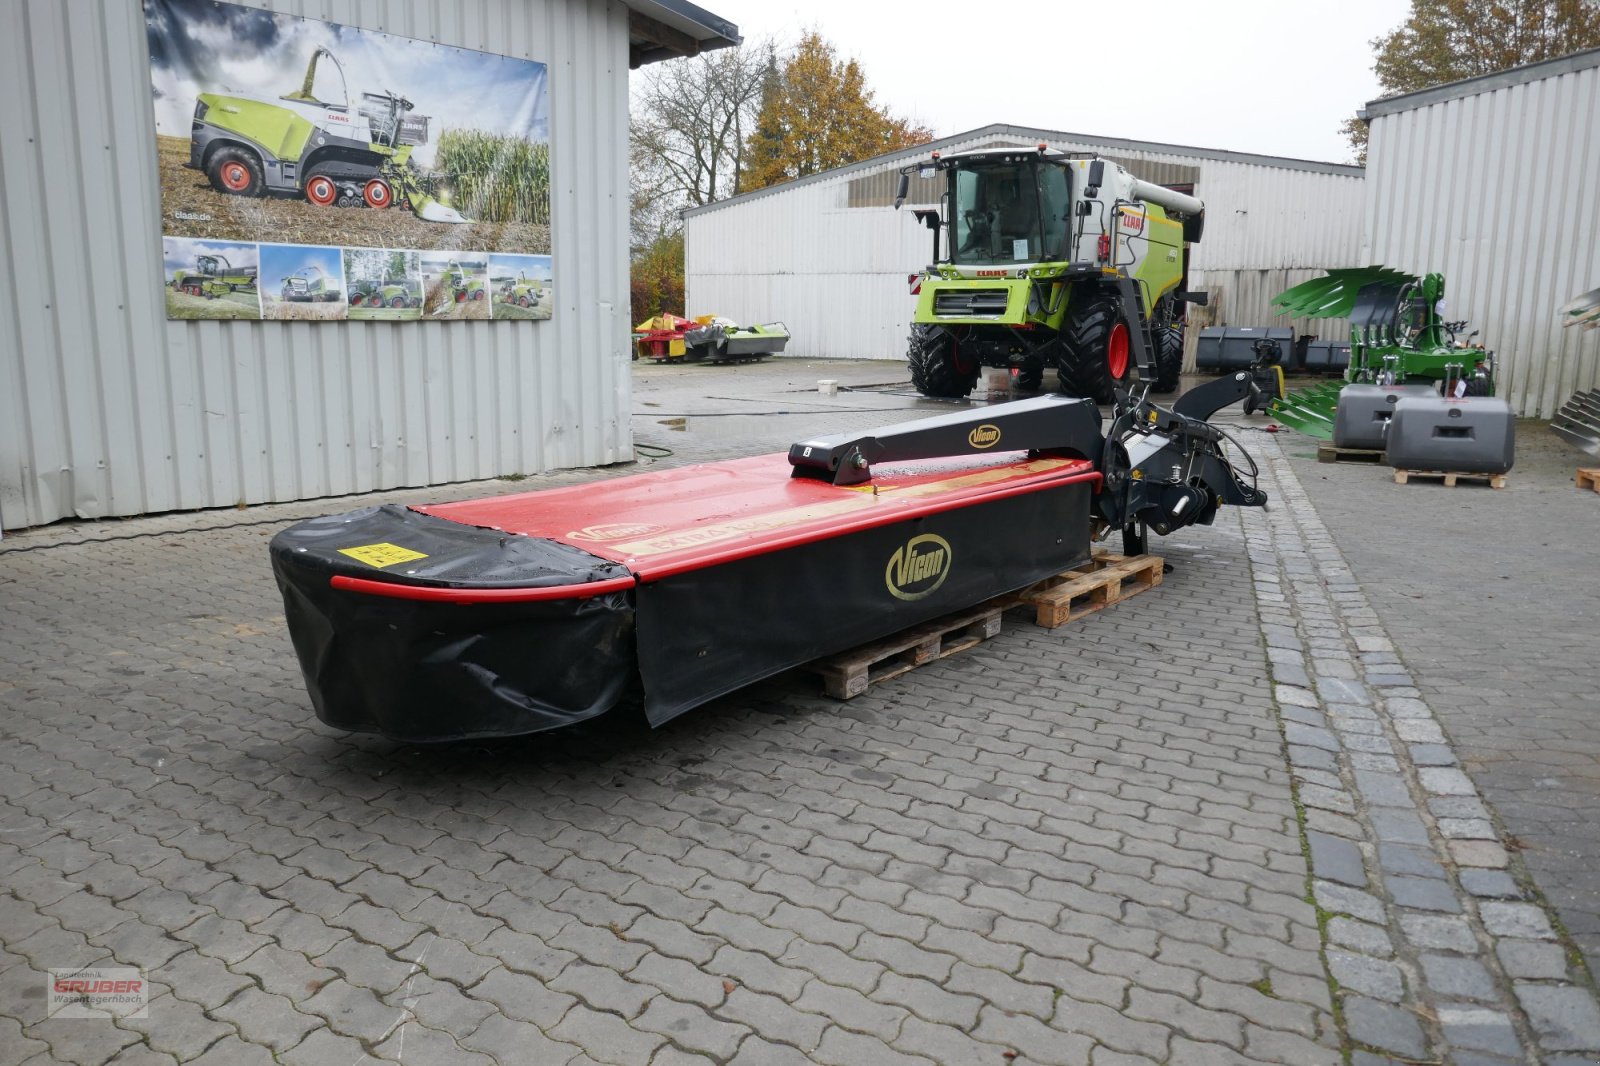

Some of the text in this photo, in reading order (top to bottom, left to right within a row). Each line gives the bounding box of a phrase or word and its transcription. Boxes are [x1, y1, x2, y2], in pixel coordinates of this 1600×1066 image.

[328, 114, 350, 123] CLAAS
[175, 210, 211, 221] claas.de
[1123, 213, 1145, 231] CLAA
[976, 270, 1008, 278] CLAAS
[972, 426, 999, 444] Vicon
[648, 529, 728, 550] EXTRA
[893, 538, 947, 590] Vicon
